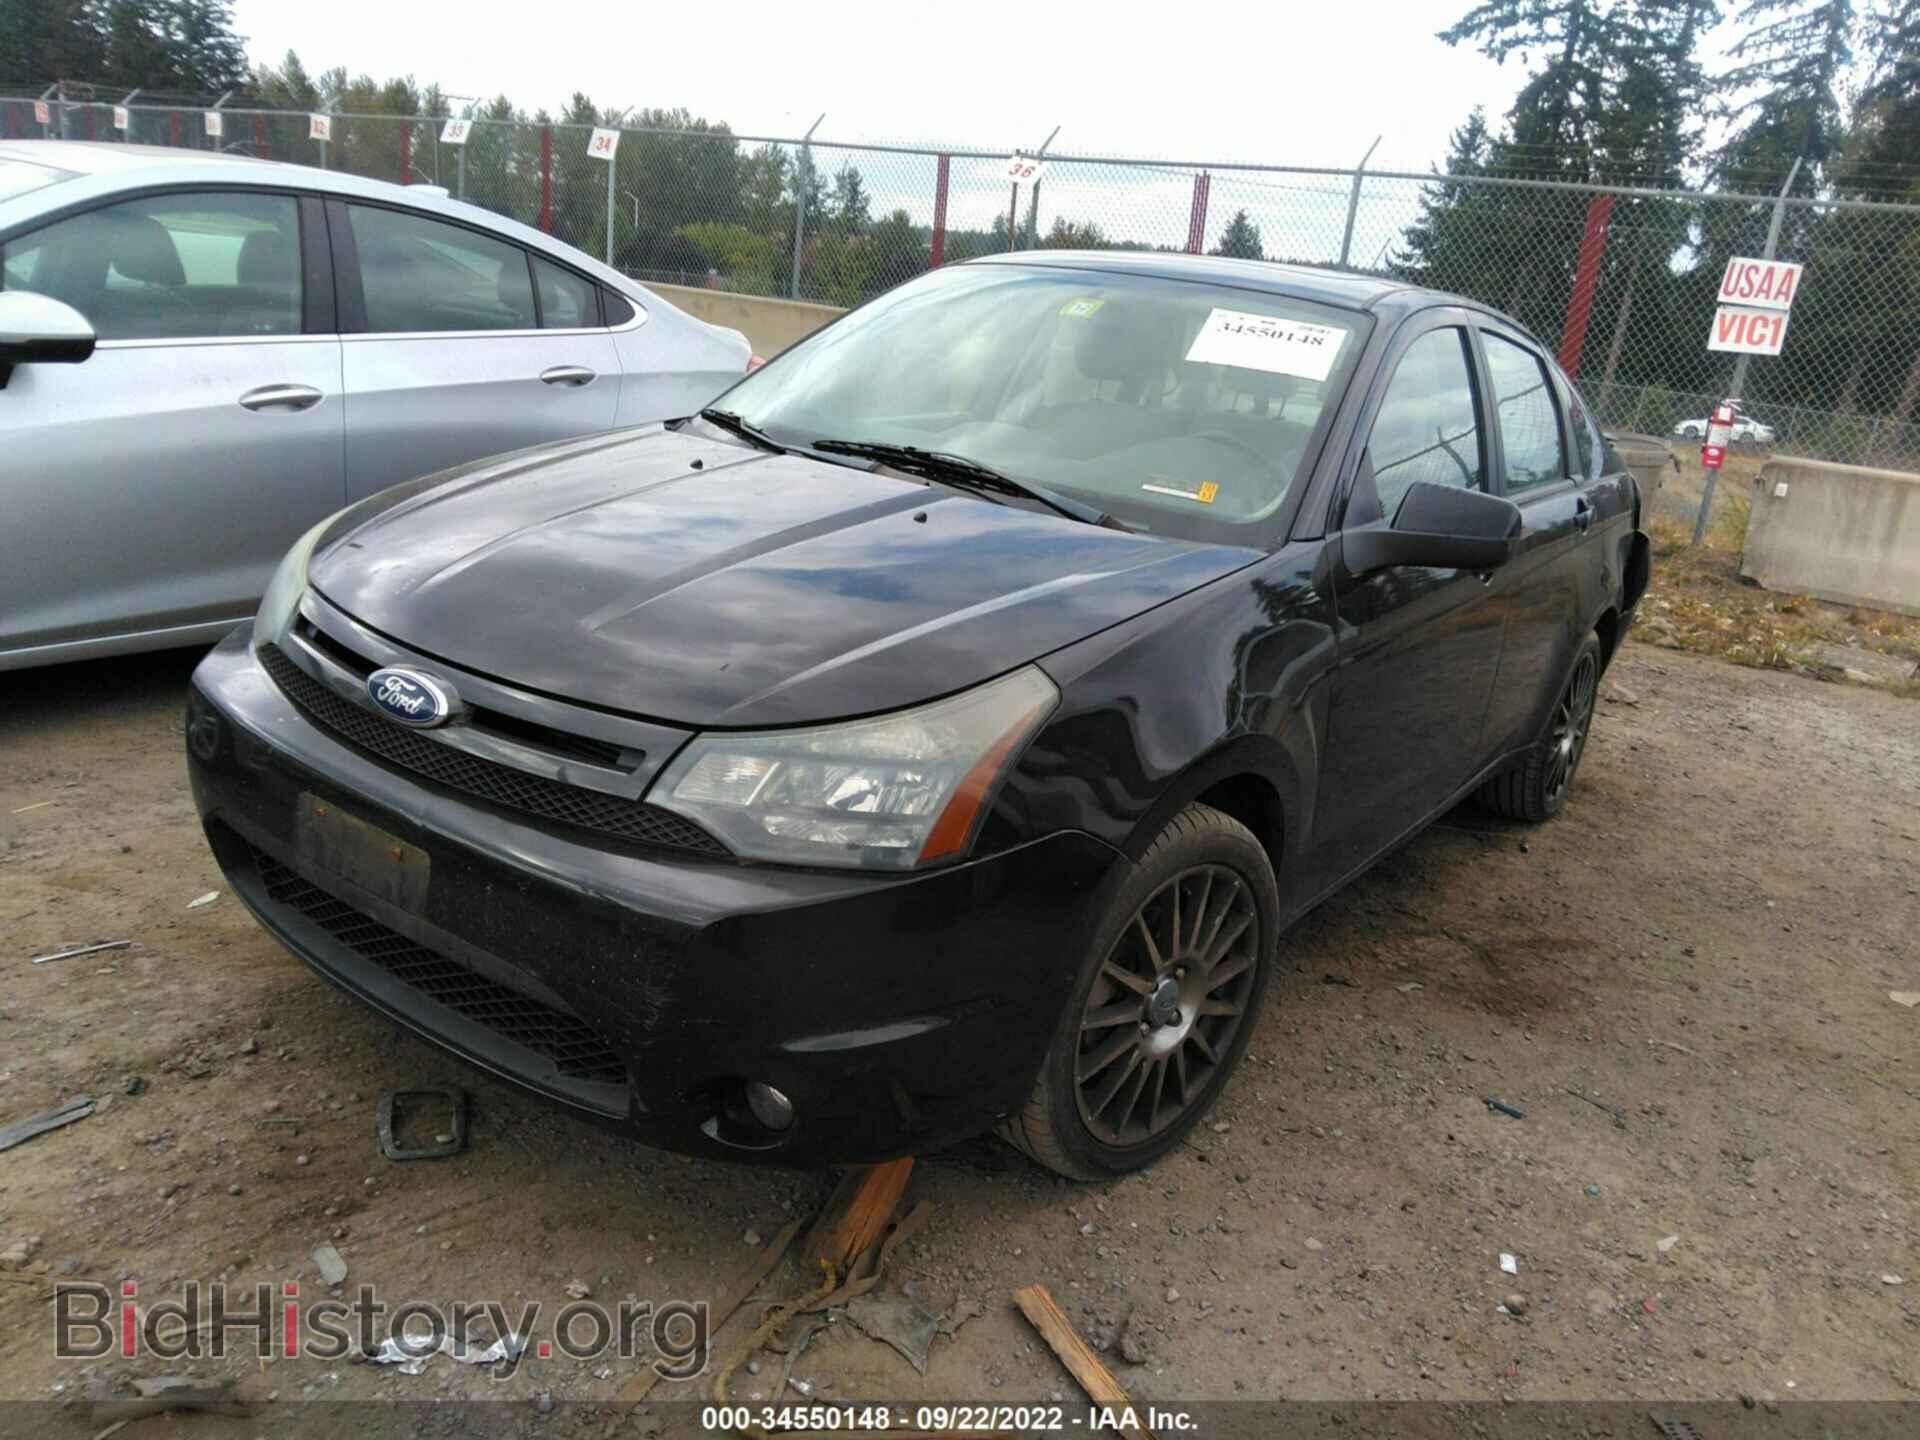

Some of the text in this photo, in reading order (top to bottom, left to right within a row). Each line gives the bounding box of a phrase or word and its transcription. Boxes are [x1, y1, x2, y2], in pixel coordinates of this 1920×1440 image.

[448, 124, 465, 138] 33
[595, 136, 612, 152] 34
[1009, 162, 1036, 178] 36
[1722, 262, 1796, 302] USAA
[1718, 314, 1784, 347] VIC1
[377, 675, 425, 714] Ford
